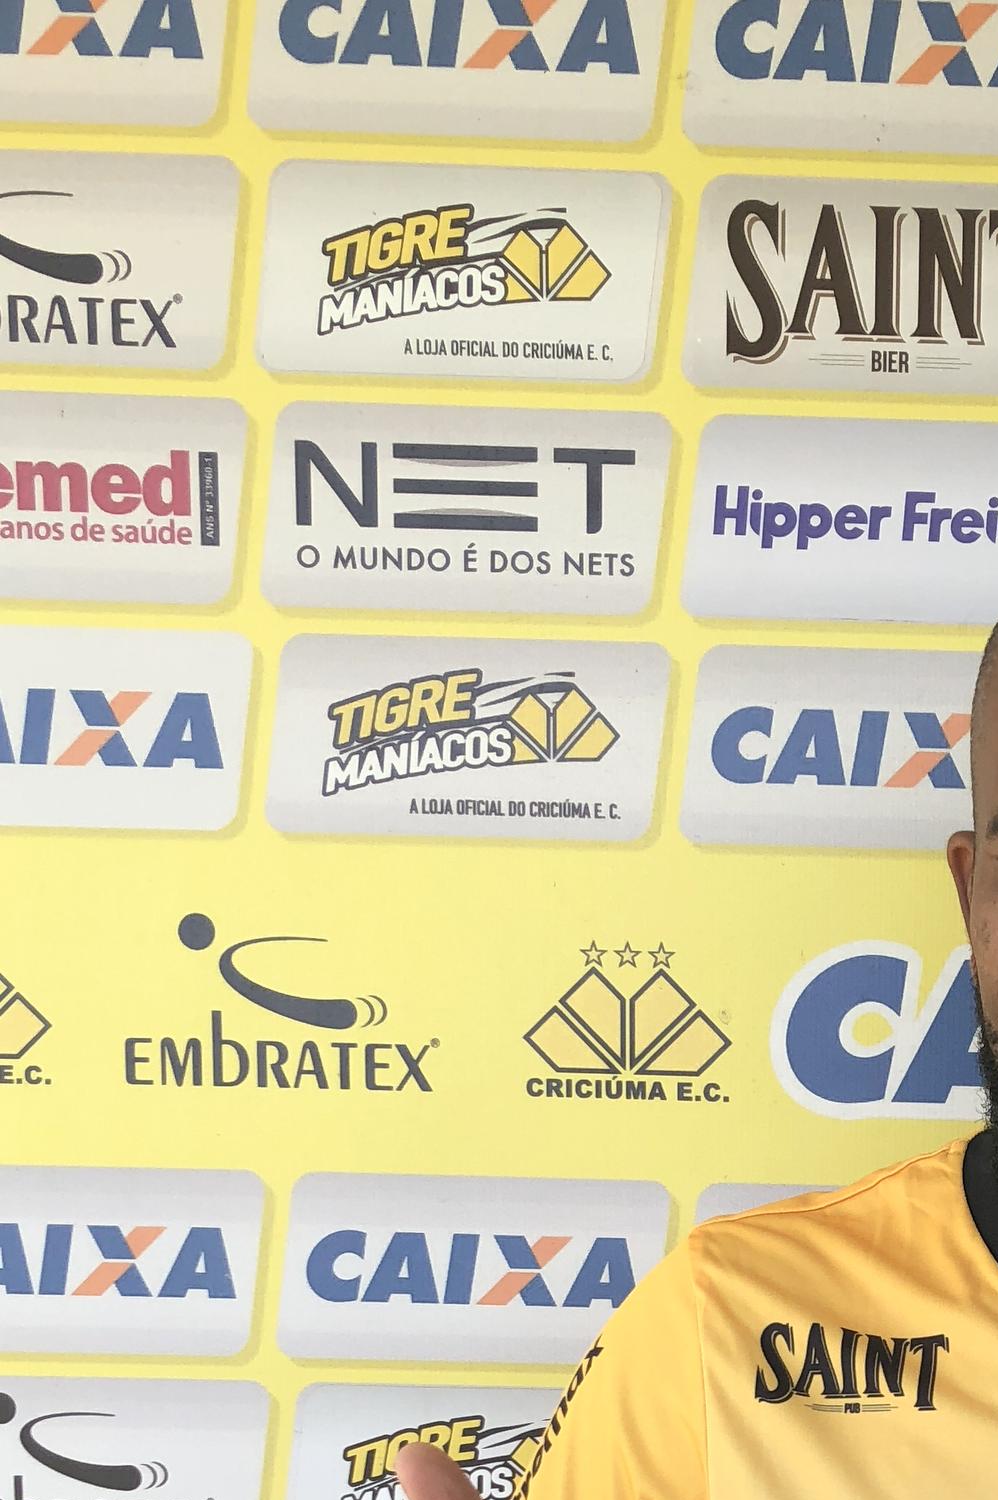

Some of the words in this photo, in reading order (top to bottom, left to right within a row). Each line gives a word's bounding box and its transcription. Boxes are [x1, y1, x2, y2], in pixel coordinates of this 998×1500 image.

[0, 0, 203, 59] IXA
[278, 0, 639, 75] CAIXA
[322, 204, 474, 285] TIGRE
[7, 293, 177, 348] RATEX
[317, 264, 508, 335] MANÍACOS
[417, 339, 447, 356] LOJA
[451, 340, 498, 357] OFICIAL
[502, 342, 519, 358] DO
[523, 340, 583, 360] CRICIÚMA
[871, 351, 909, 373] BIER
[0, 450, 192, 517] med
[294, 439, 636, 535] NET
[712, 484, 891, 550] Hipper
[70, 516, 105, 542] de
[112, 519, 193, 546] saúde
[296, 545, 320, 568] O
[334, 546, 450, 573] MUNDO
[463, 543, 479, 573] É
[490, 550, 551, 575] DOS
[564, 552, 635, 578] NETS
[0, 688, 224, 769] IXA
[327, 668, 482, 751] TIGRE
[322, 727, 515, 796] MANÍACOS
[711, 706, 973, 789] CAIX
[422, 799, 453, 815] LOJA
[457, 800, 505, 816] OFICIAL
[509, 801, 525, 816] DO
[530, 799, 590, 819] CRICIÚMA
[527, 1076, 667, 1100] CRICIÚMA
[677, 1083, 730, 1102] E.C.
[0, 1223, 236, 1299] AIXA
[306, 1229, 637, 1308] CAIXA
[755, 1322, 950, 1411] SAINT
